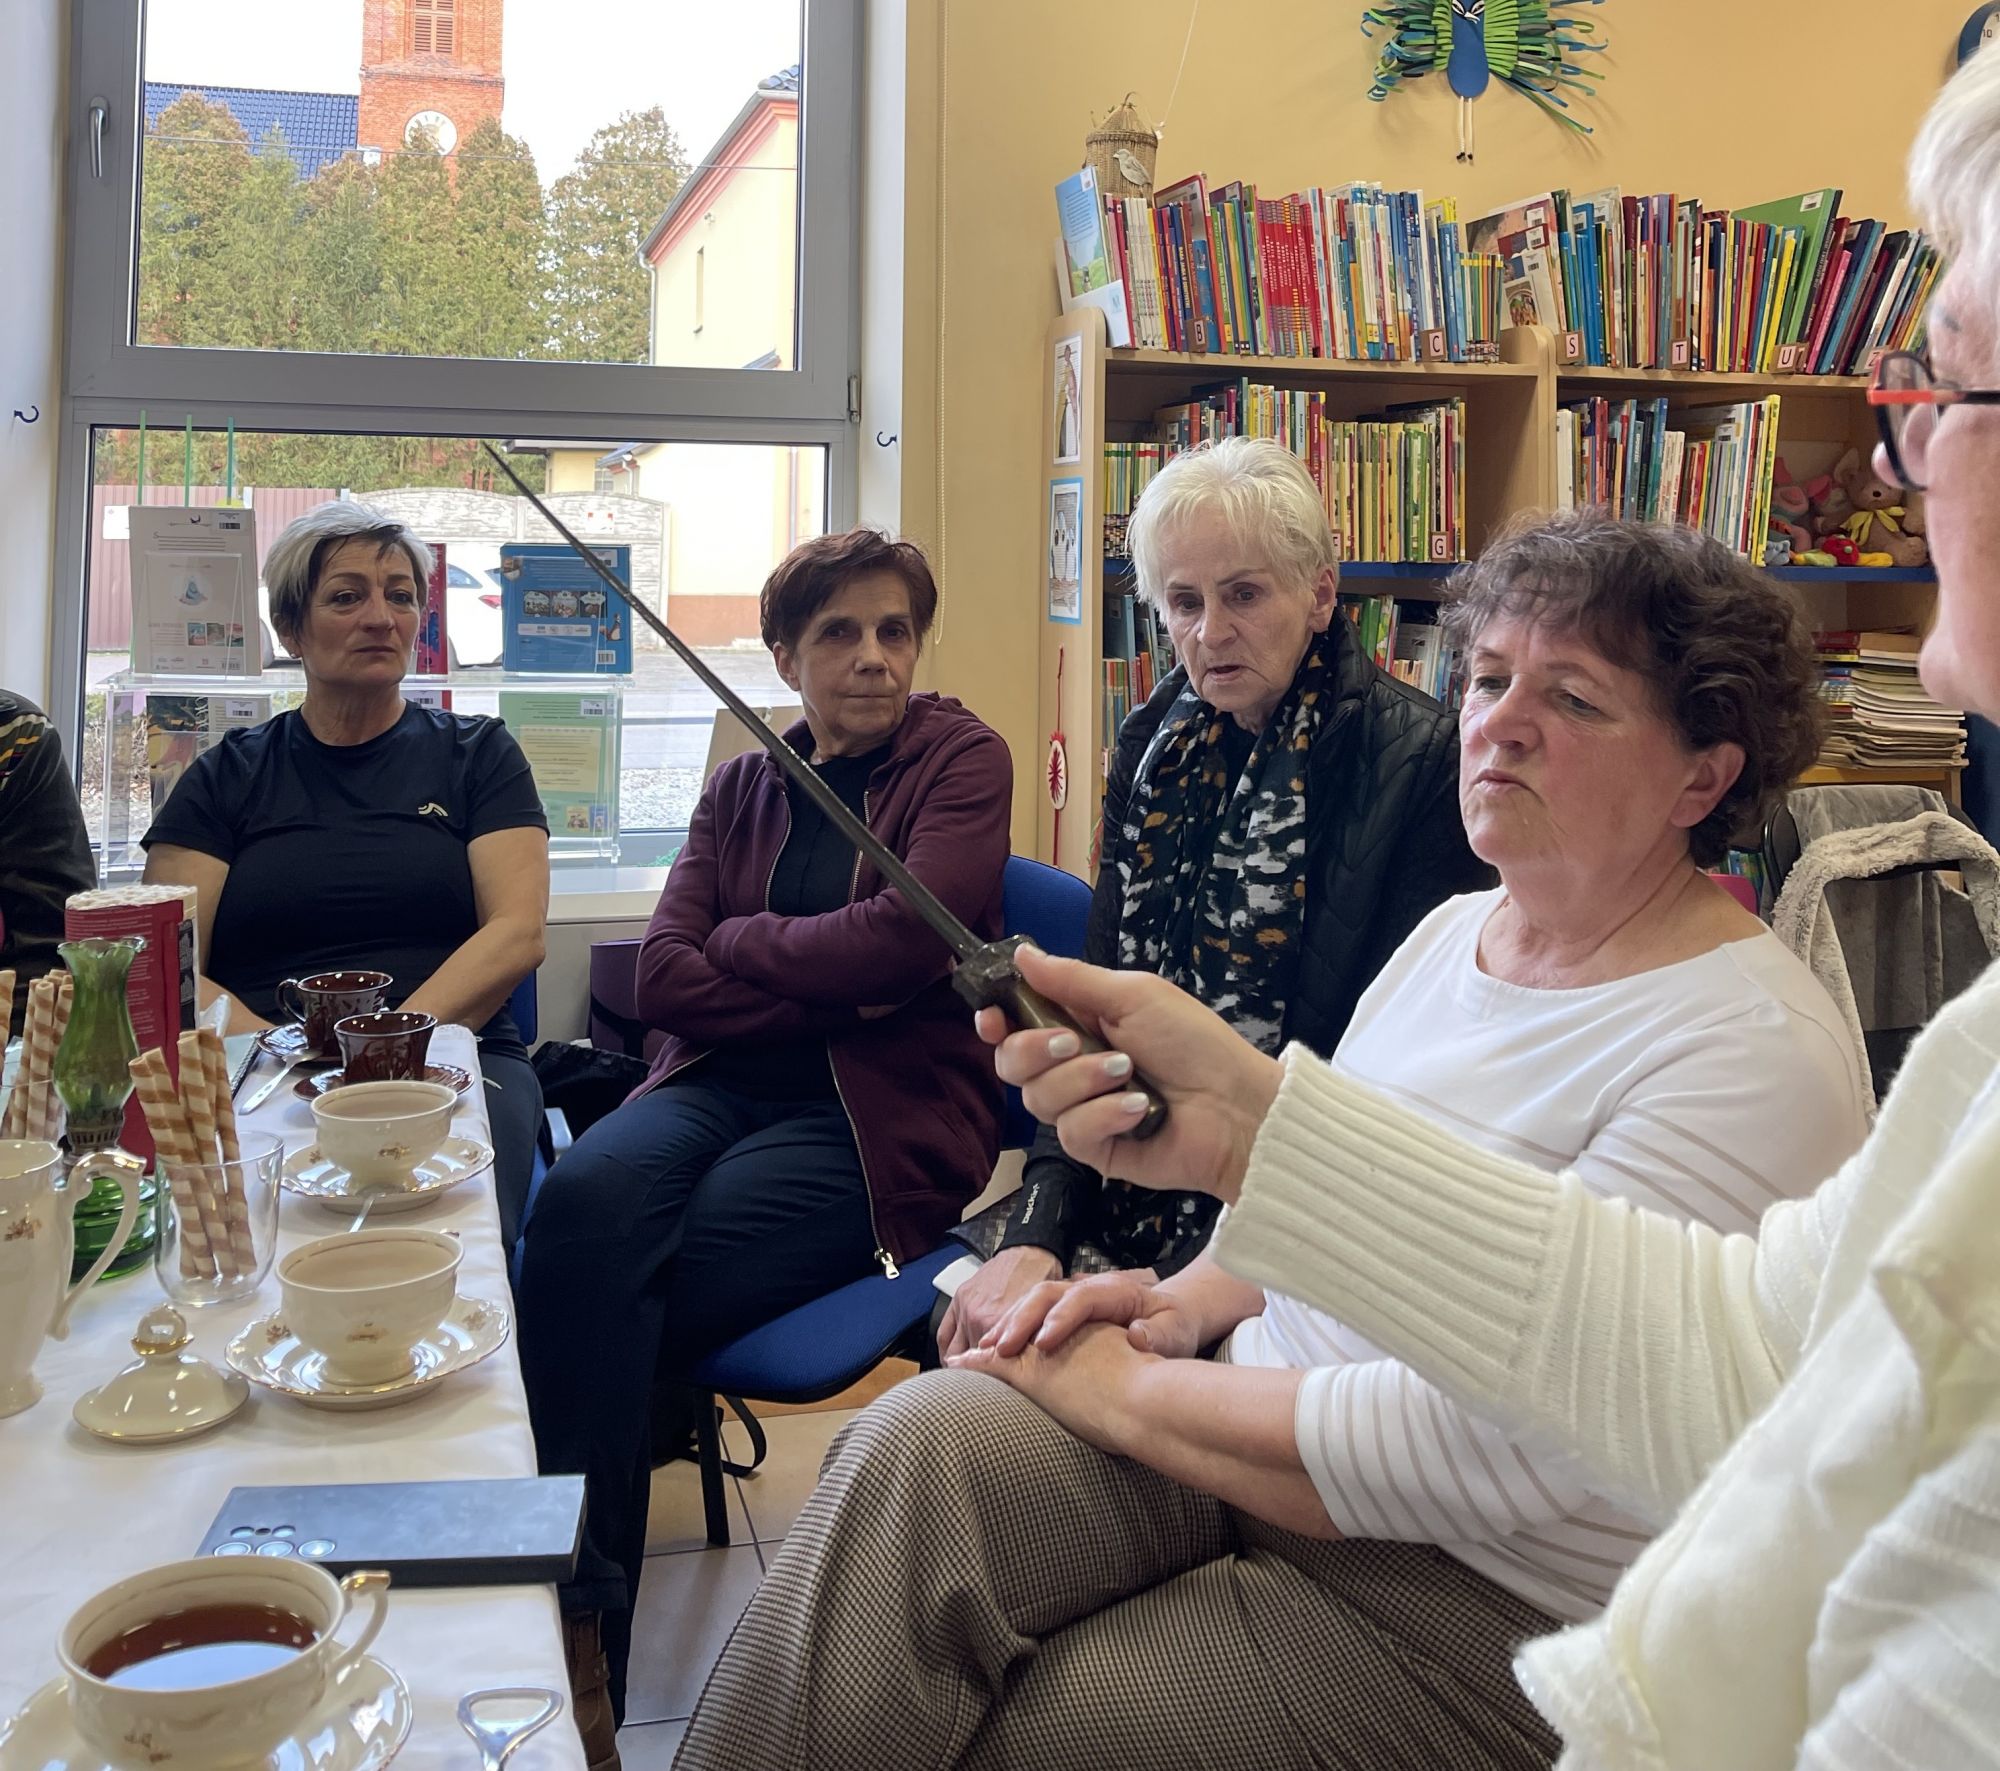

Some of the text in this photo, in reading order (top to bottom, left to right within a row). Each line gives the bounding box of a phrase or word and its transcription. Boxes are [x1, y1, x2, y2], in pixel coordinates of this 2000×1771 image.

[1983, 29, 1993, 38] 10
[1196, 324, 1203, 342] B
[1432, 335, 1441, 353] C
[1569, 337, 1576, 354] S
[1675, 343, 1685, 361] T
[1781, 348, 1793, 365] U
[1434, 538, 1444, 556] G
